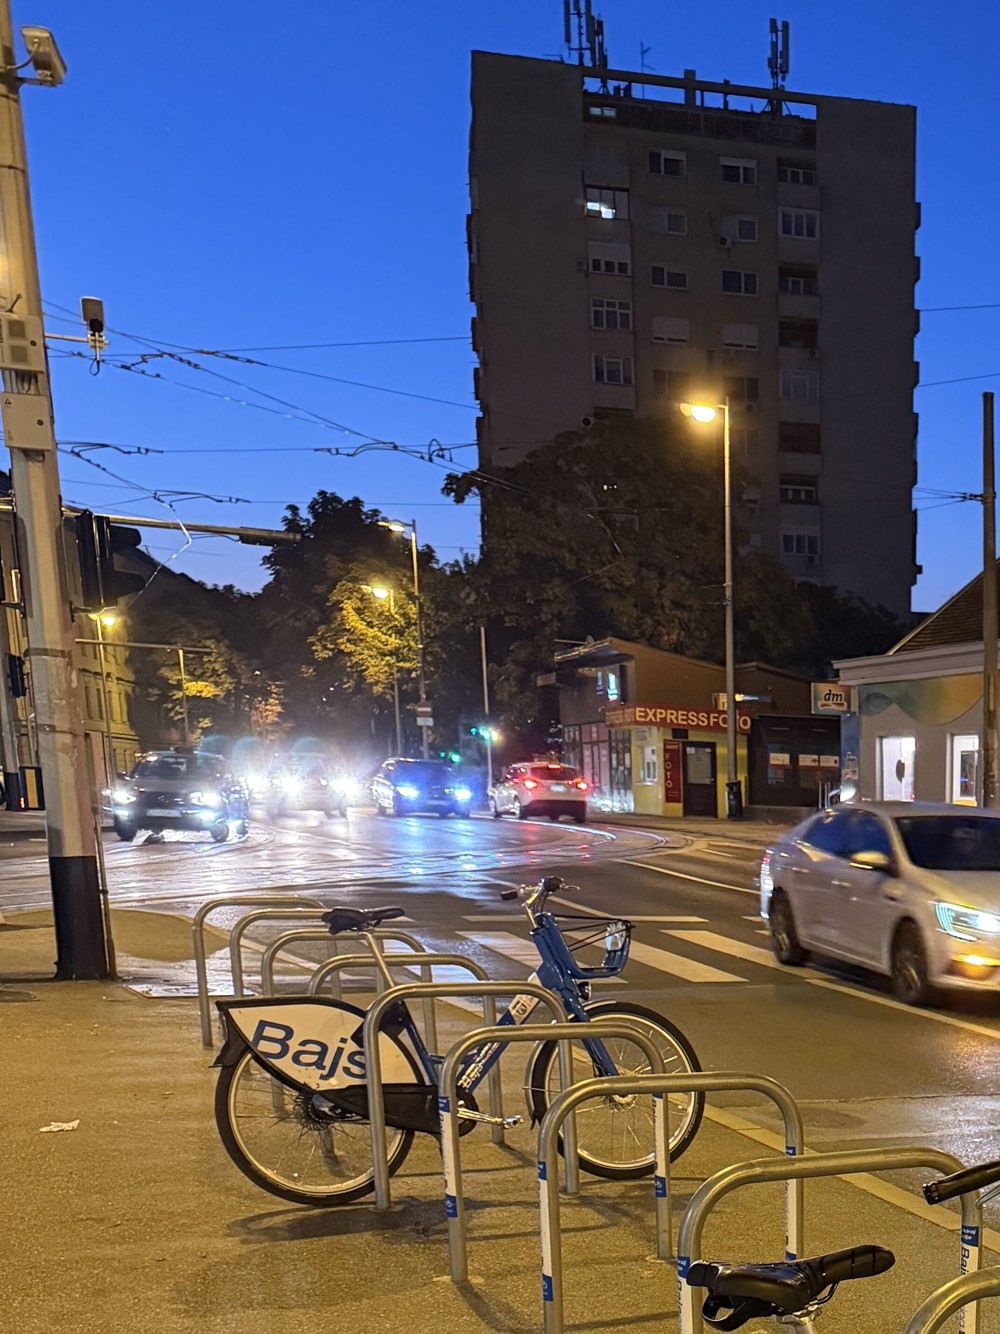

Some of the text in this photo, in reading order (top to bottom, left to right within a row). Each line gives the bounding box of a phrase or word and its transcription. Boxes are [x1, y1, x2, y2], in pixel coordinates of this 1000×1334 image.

[824, 689, 843, 702] dm
[635, 707, 708, 727] EXPRESS
[709, 713, 751, 730] FOO
[251, 1019, 367, 1081] Bajs
